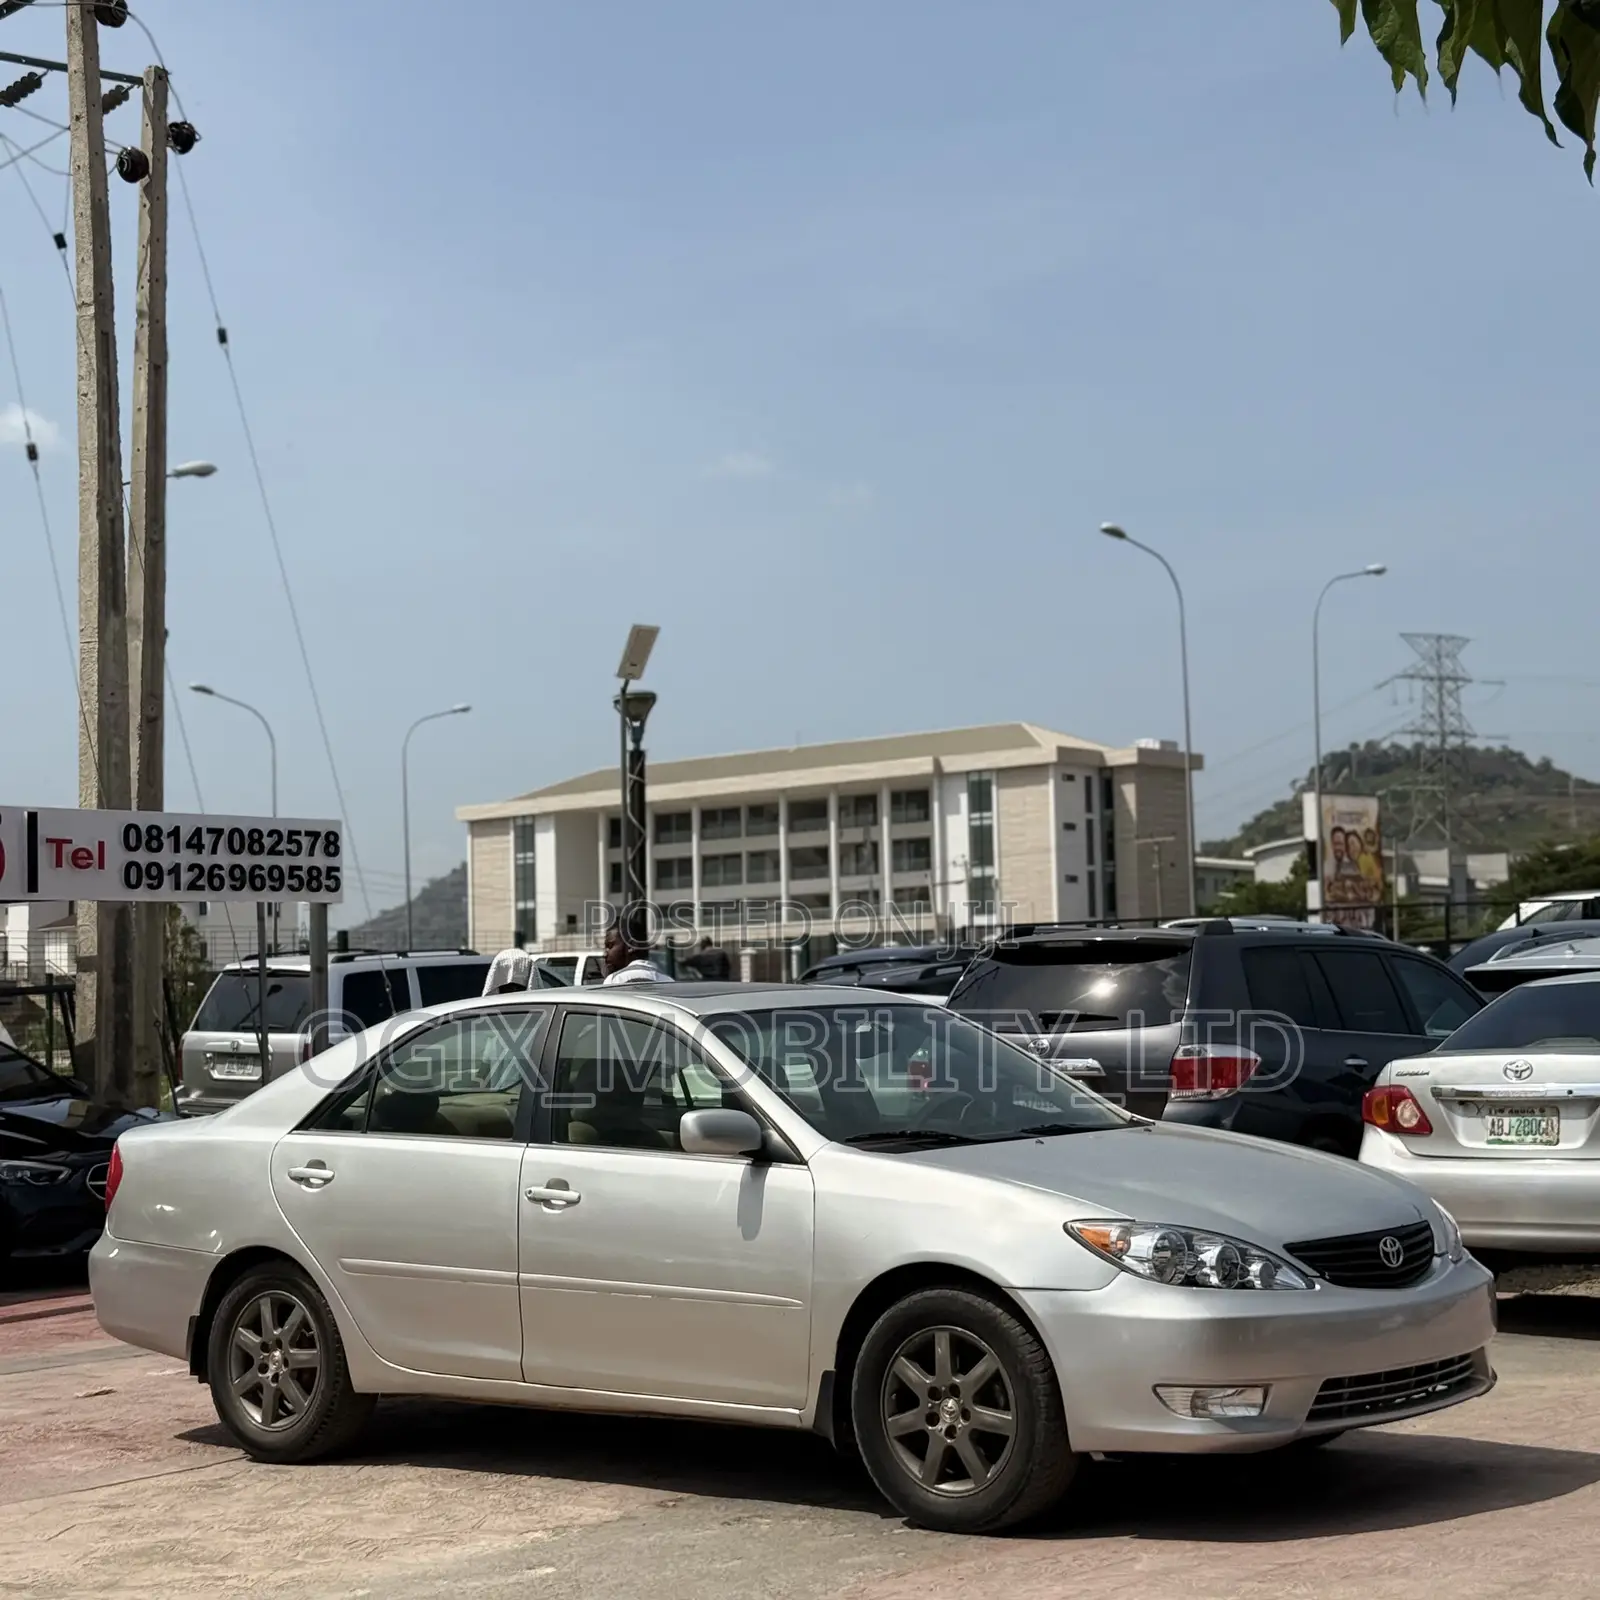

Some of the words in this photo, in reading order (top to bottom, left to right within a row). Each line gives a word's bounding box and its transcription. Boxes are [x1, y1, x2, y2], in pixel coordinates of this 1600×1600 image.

[46, 837, 106, 871] Tel
[122, 823, 341, 858] 08147082578
[123, 860, 342, 893] 09126969585
